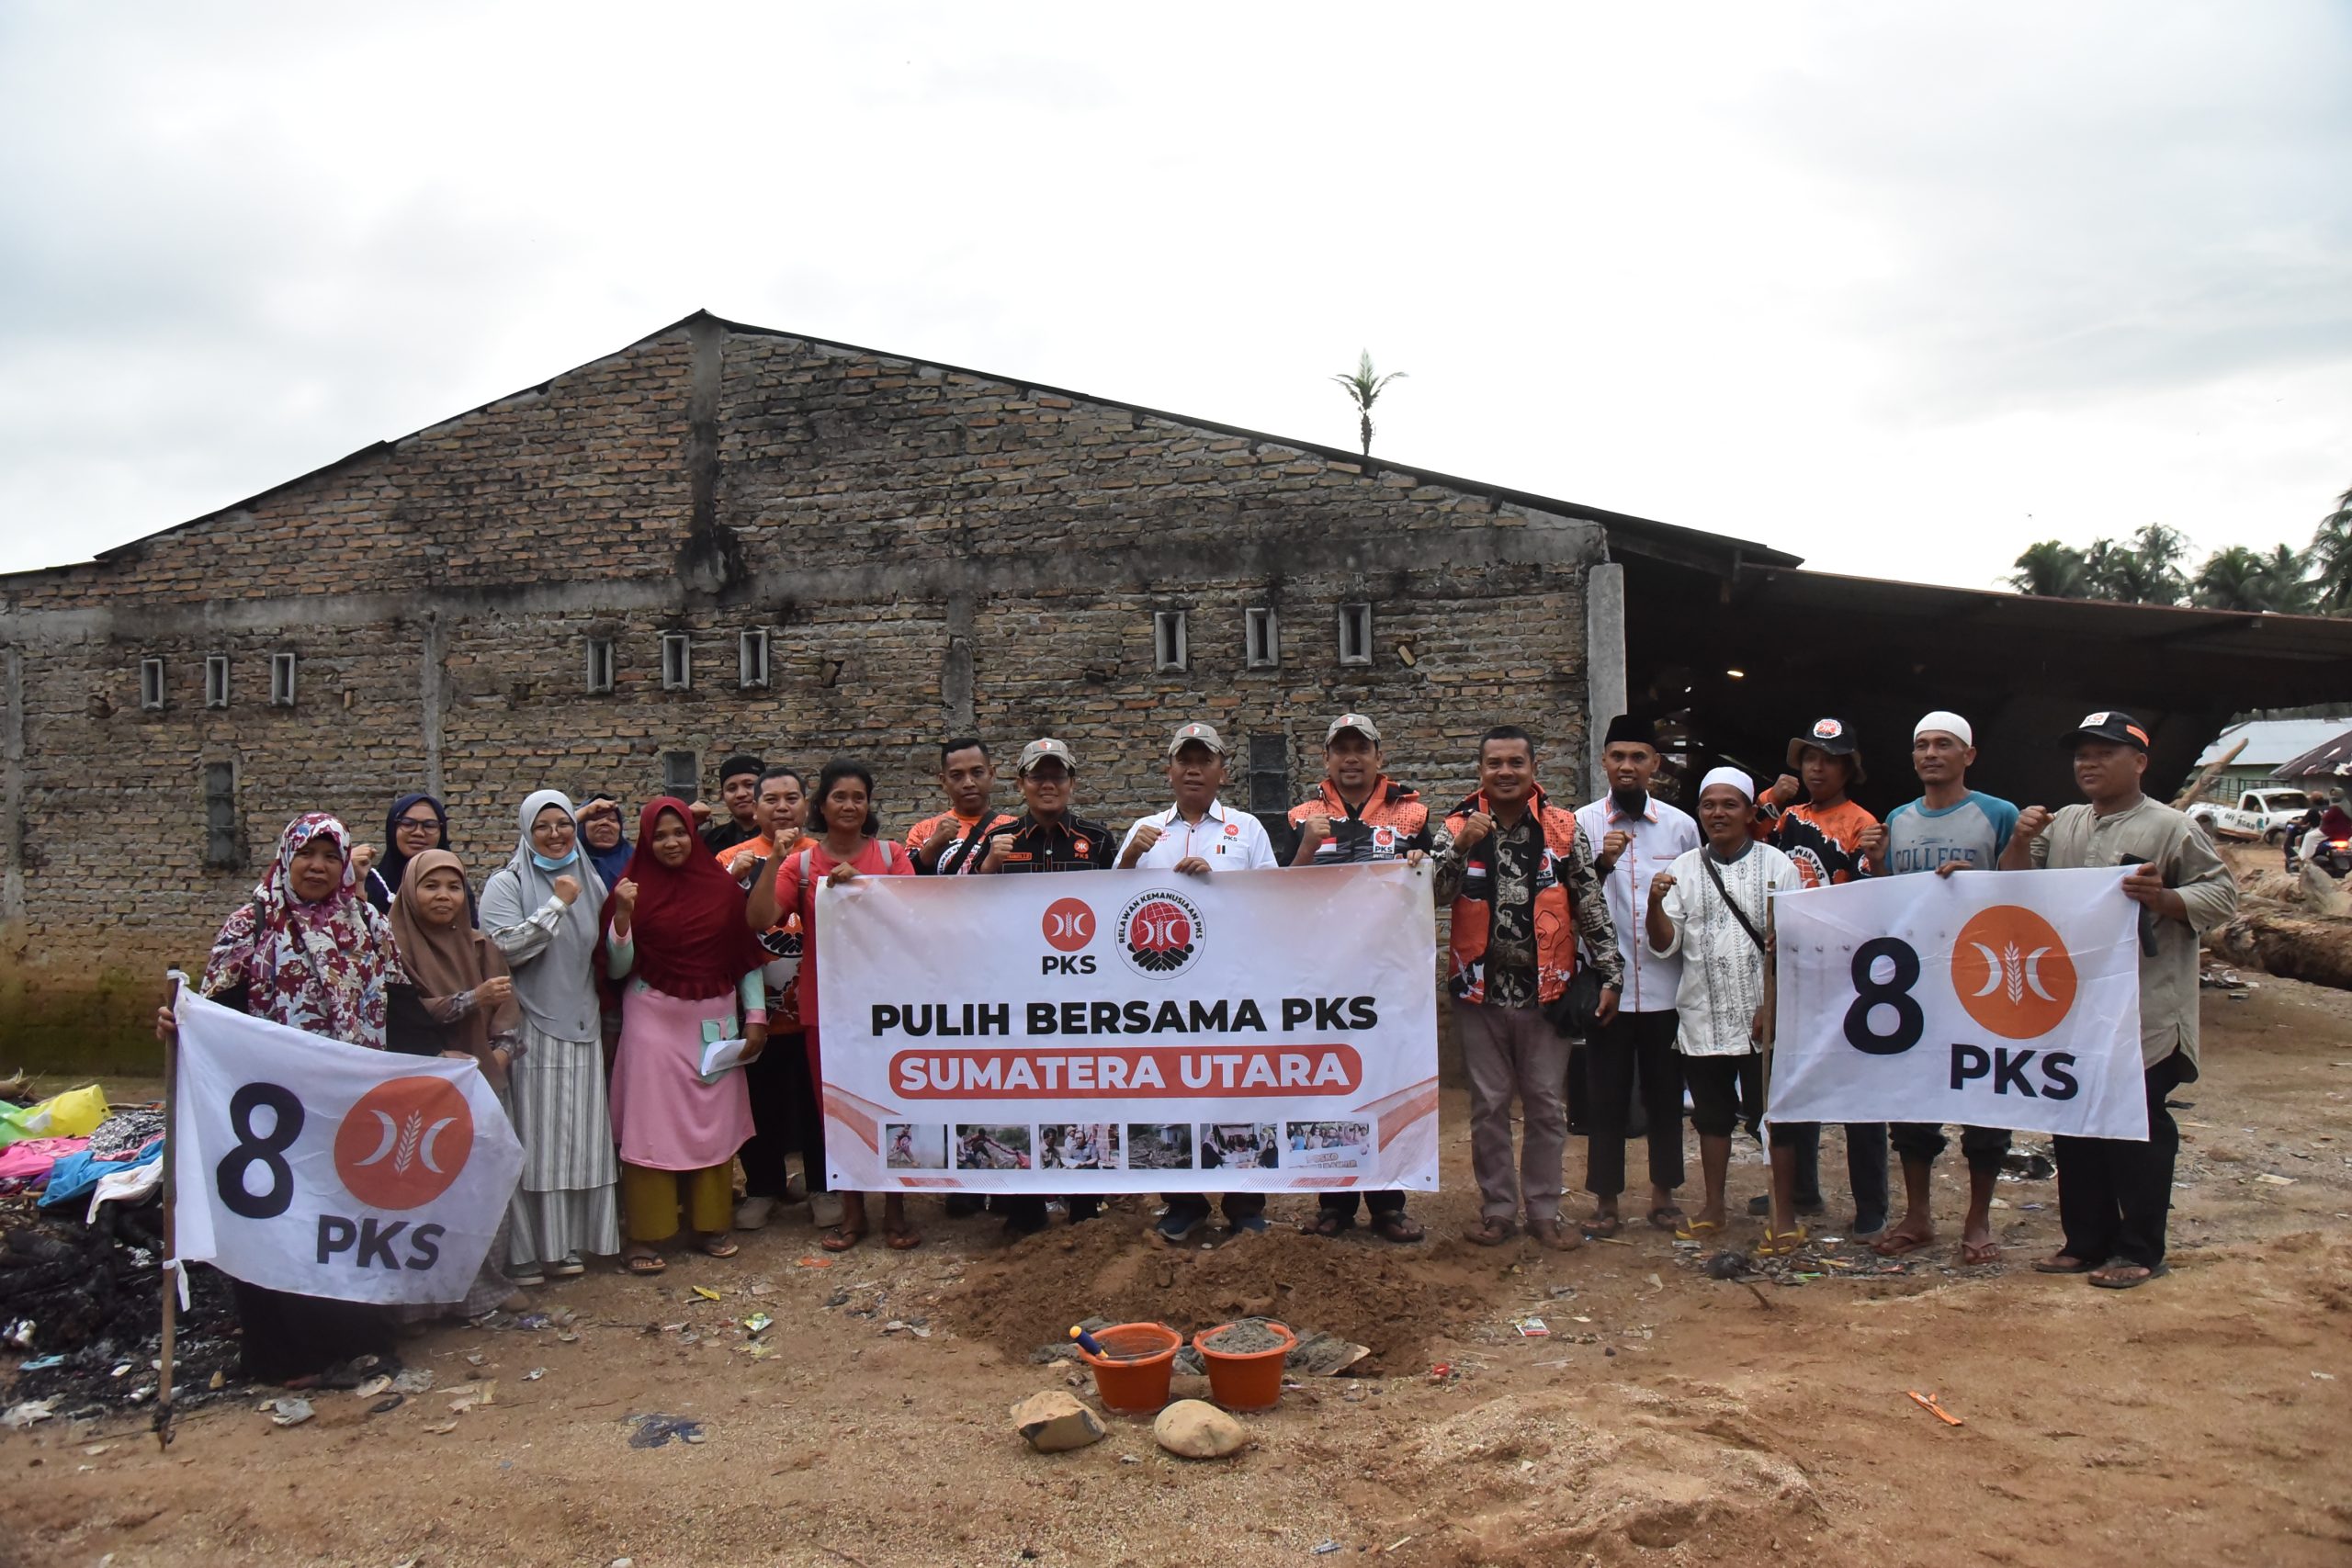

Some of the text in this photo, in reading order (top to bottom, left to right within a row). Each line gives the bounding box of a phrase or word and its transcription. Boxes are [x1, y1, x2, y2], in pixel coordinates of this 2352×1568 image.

[1812, 859, 1826, 880] PKS
[1118, 892, 1204, 944] RELAWAN KEMANUSIAAN PKS
[1042, 954, 1097, 976] PKS
[872, 996, 1378, 1037] PULIH BERSAMA PKS
[1843, 937, 1925, 1055] 8
[900, 1053, 1351, 1090] SUMATERA UTARA
[1950, 1043, 2079, 1101] PKS
[216, 1081, 306, 1220] 8
[316, 1213, 447, 1273] PKS
